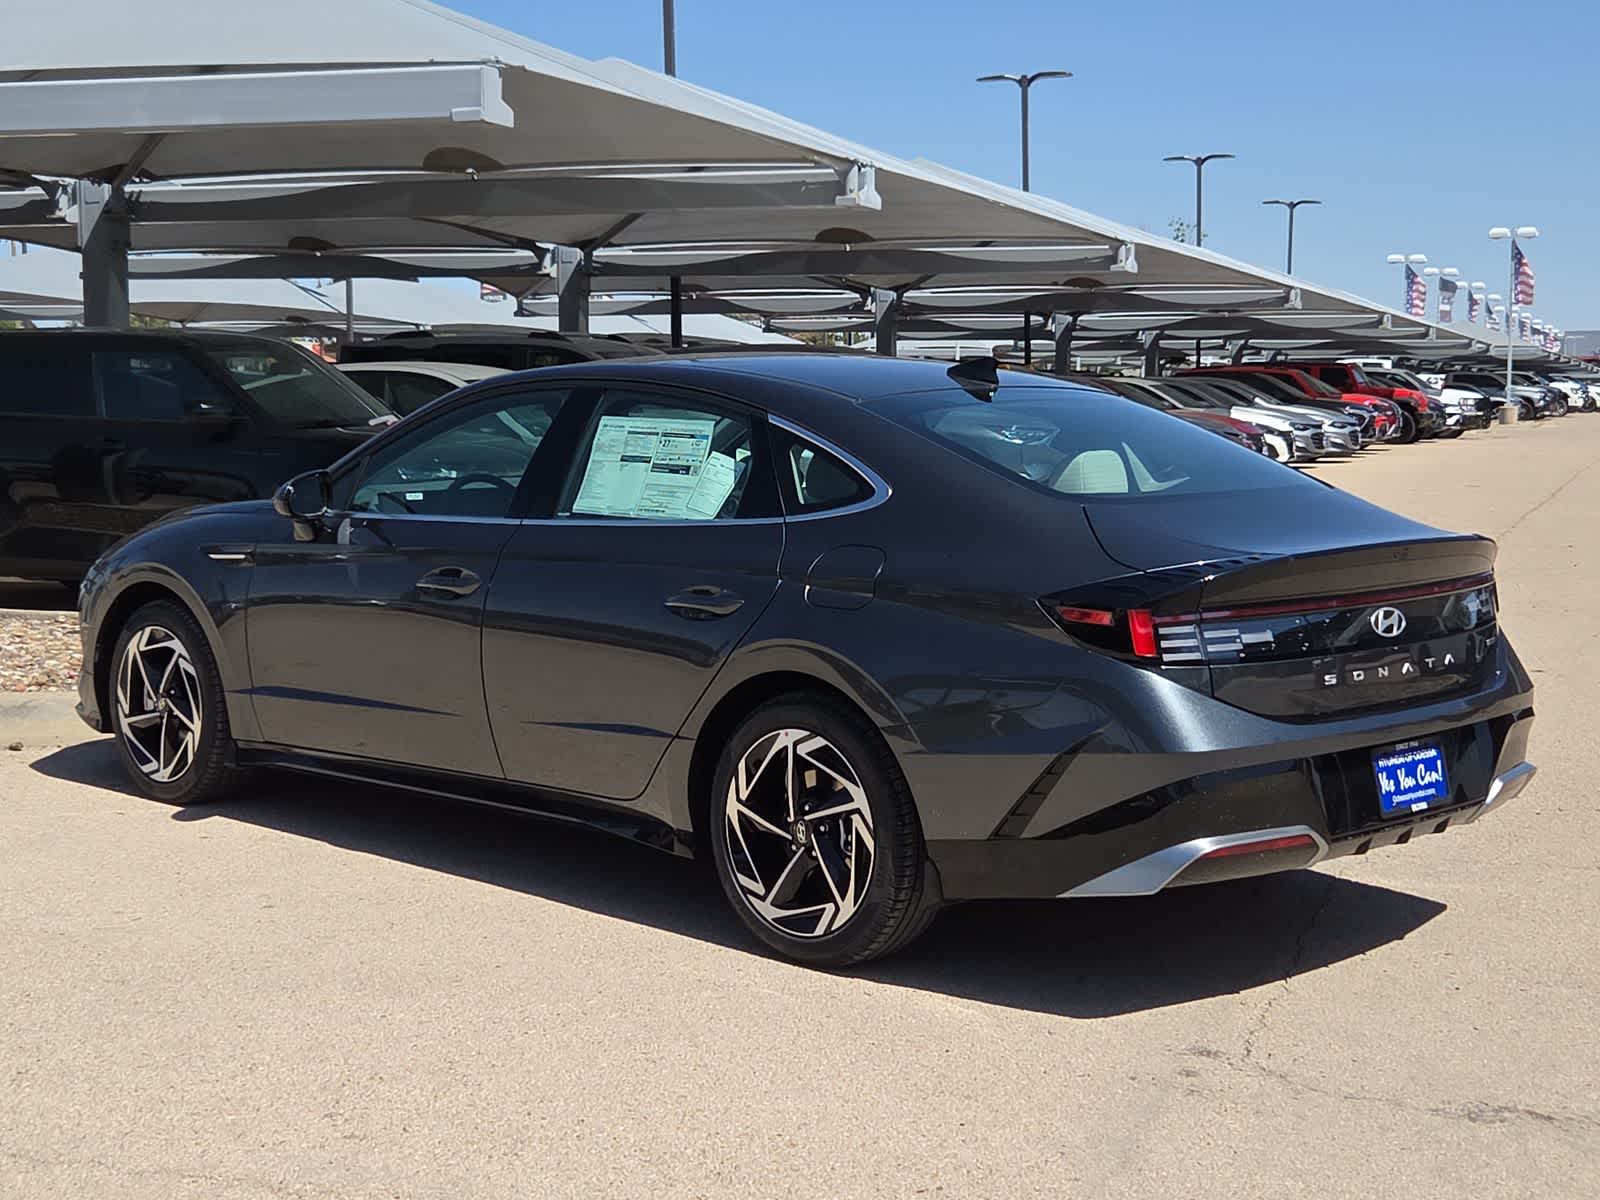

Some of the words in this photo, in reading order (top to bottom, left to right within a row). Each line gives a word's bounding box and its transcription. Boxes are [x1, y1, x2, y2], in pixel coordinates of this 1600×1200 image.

[1324, 653, 1455, 685] SONATA
[1378, 770, 1395, 795] Yes
[1397, 767, 1416, 790] You
[1417, 759, 1443, 785] Can!
